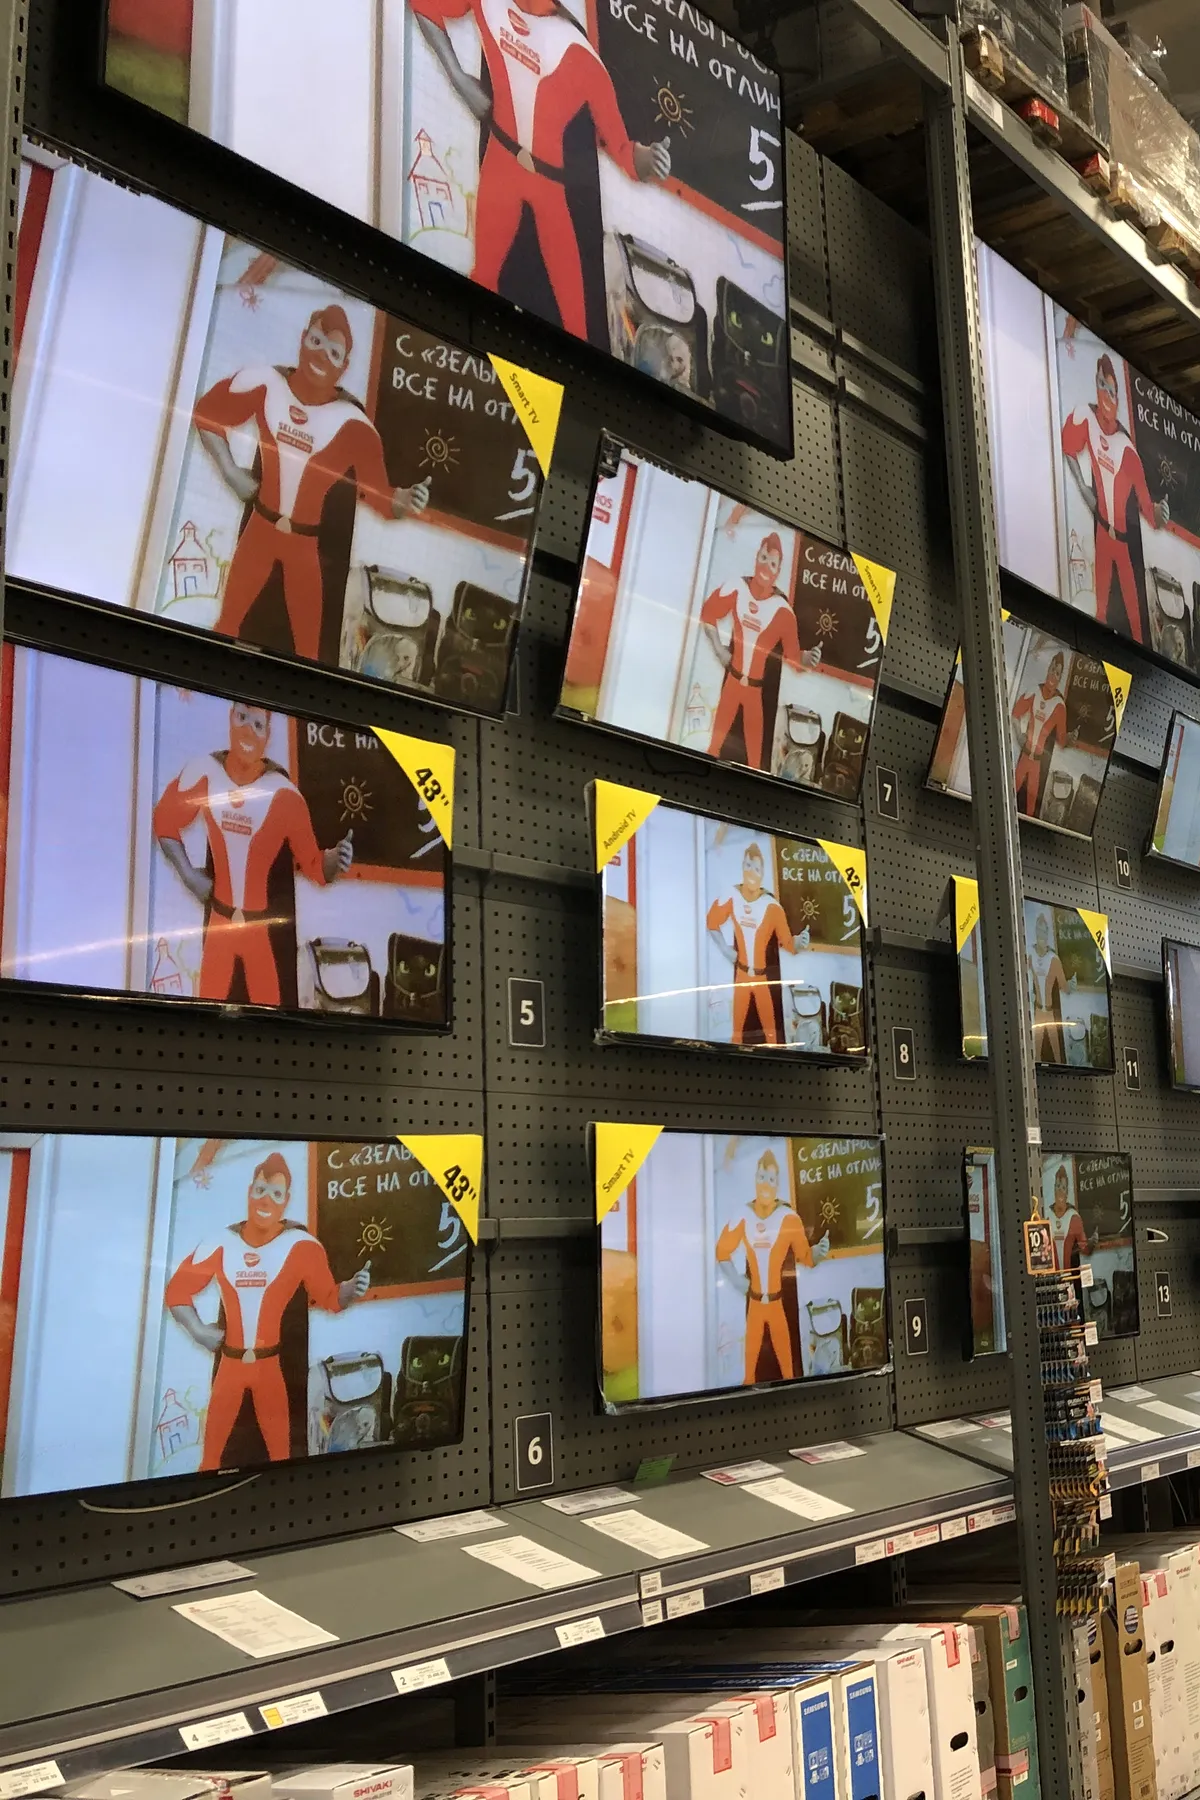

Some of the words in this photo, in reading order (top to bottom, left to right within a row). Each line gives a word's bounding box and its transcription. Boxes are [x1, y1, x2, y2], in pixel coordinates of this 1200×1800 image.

[670, 29, 699, 67] НА
[749, 126, 781, 191] 5
[392, 367, 438, 400] ВСЕ
[448, 384, 474, 411] НА
[509, 373, 530, 409] Smart
[527, 408, 540, 424] TV
[1137, 403, 1160, 431] ВСЕ
[1163, 418, 1178, 441] НА
[508, 448, 536, 501] 5
[803, 569, 828, 591] ВСЕ
[832, 577, 847, 594] НА
[865, 565, 877, 593] Smart
[864, 617, 881, 654] 5
[1073, 674, 1089, 689] ВСЕ
[1089, 679, 1099, 691] НА
[307, 722, 346, 748] ВСЕ
[415, 768, 449, 806] 43"
[882, 782, 892, 802] 7
[603, 819, 630, 850] Android
[626, 809, 638, 822] TV
[782, 867, 805, 882] ВСЕ
[808, 868, 822, 882] НА
[1118, 859, 1129, 877] 10
[843, 894, 857, 927] 5
[519, 1000, 535, 1026] 5
[899, 1043, 909, 1063] 8
[1127, 1060, 1138, 1078] 11
[327, 1150, 343, 1169] С
[602, 1164, 626, 1193] Smart
[623, 1148, 635, 1164] TV
[328, 1176, 367, 1200] ВСЕ
[377, 1171, 400, 1193] НА
[409, 1170, 438, 1186] ОТ
[443, 1165, 476, 1202] 43"
[800, 1166, 823, 1185] ВСЕ
[827, 1163, 842, 1180] НА
[1080, 1179, 1094, 1192] ВСЕ
[1096, 1176, 1106, 1188] НА
[865, 1183, 882, 1222] 5
[1120, 1190, 1129, 1220] 5
[1029, 1231, 1041, 1248] 10
[1158, 1283, 1169, 1303] 13
[912, 1315, 921, 1337] 9
[528, 1436, 543, 1465] 6
[563, 1631, 570, 1640] 3
[399, 1676, 407, 1686] 2
[848, 1685, 873, 1699] SAMSUNG
[803, 1700, 828, 1716] SAMSUNG
[191, 1733, 200, 1744] 4
[353, 1780, 393, 1799] SHIVAKI
